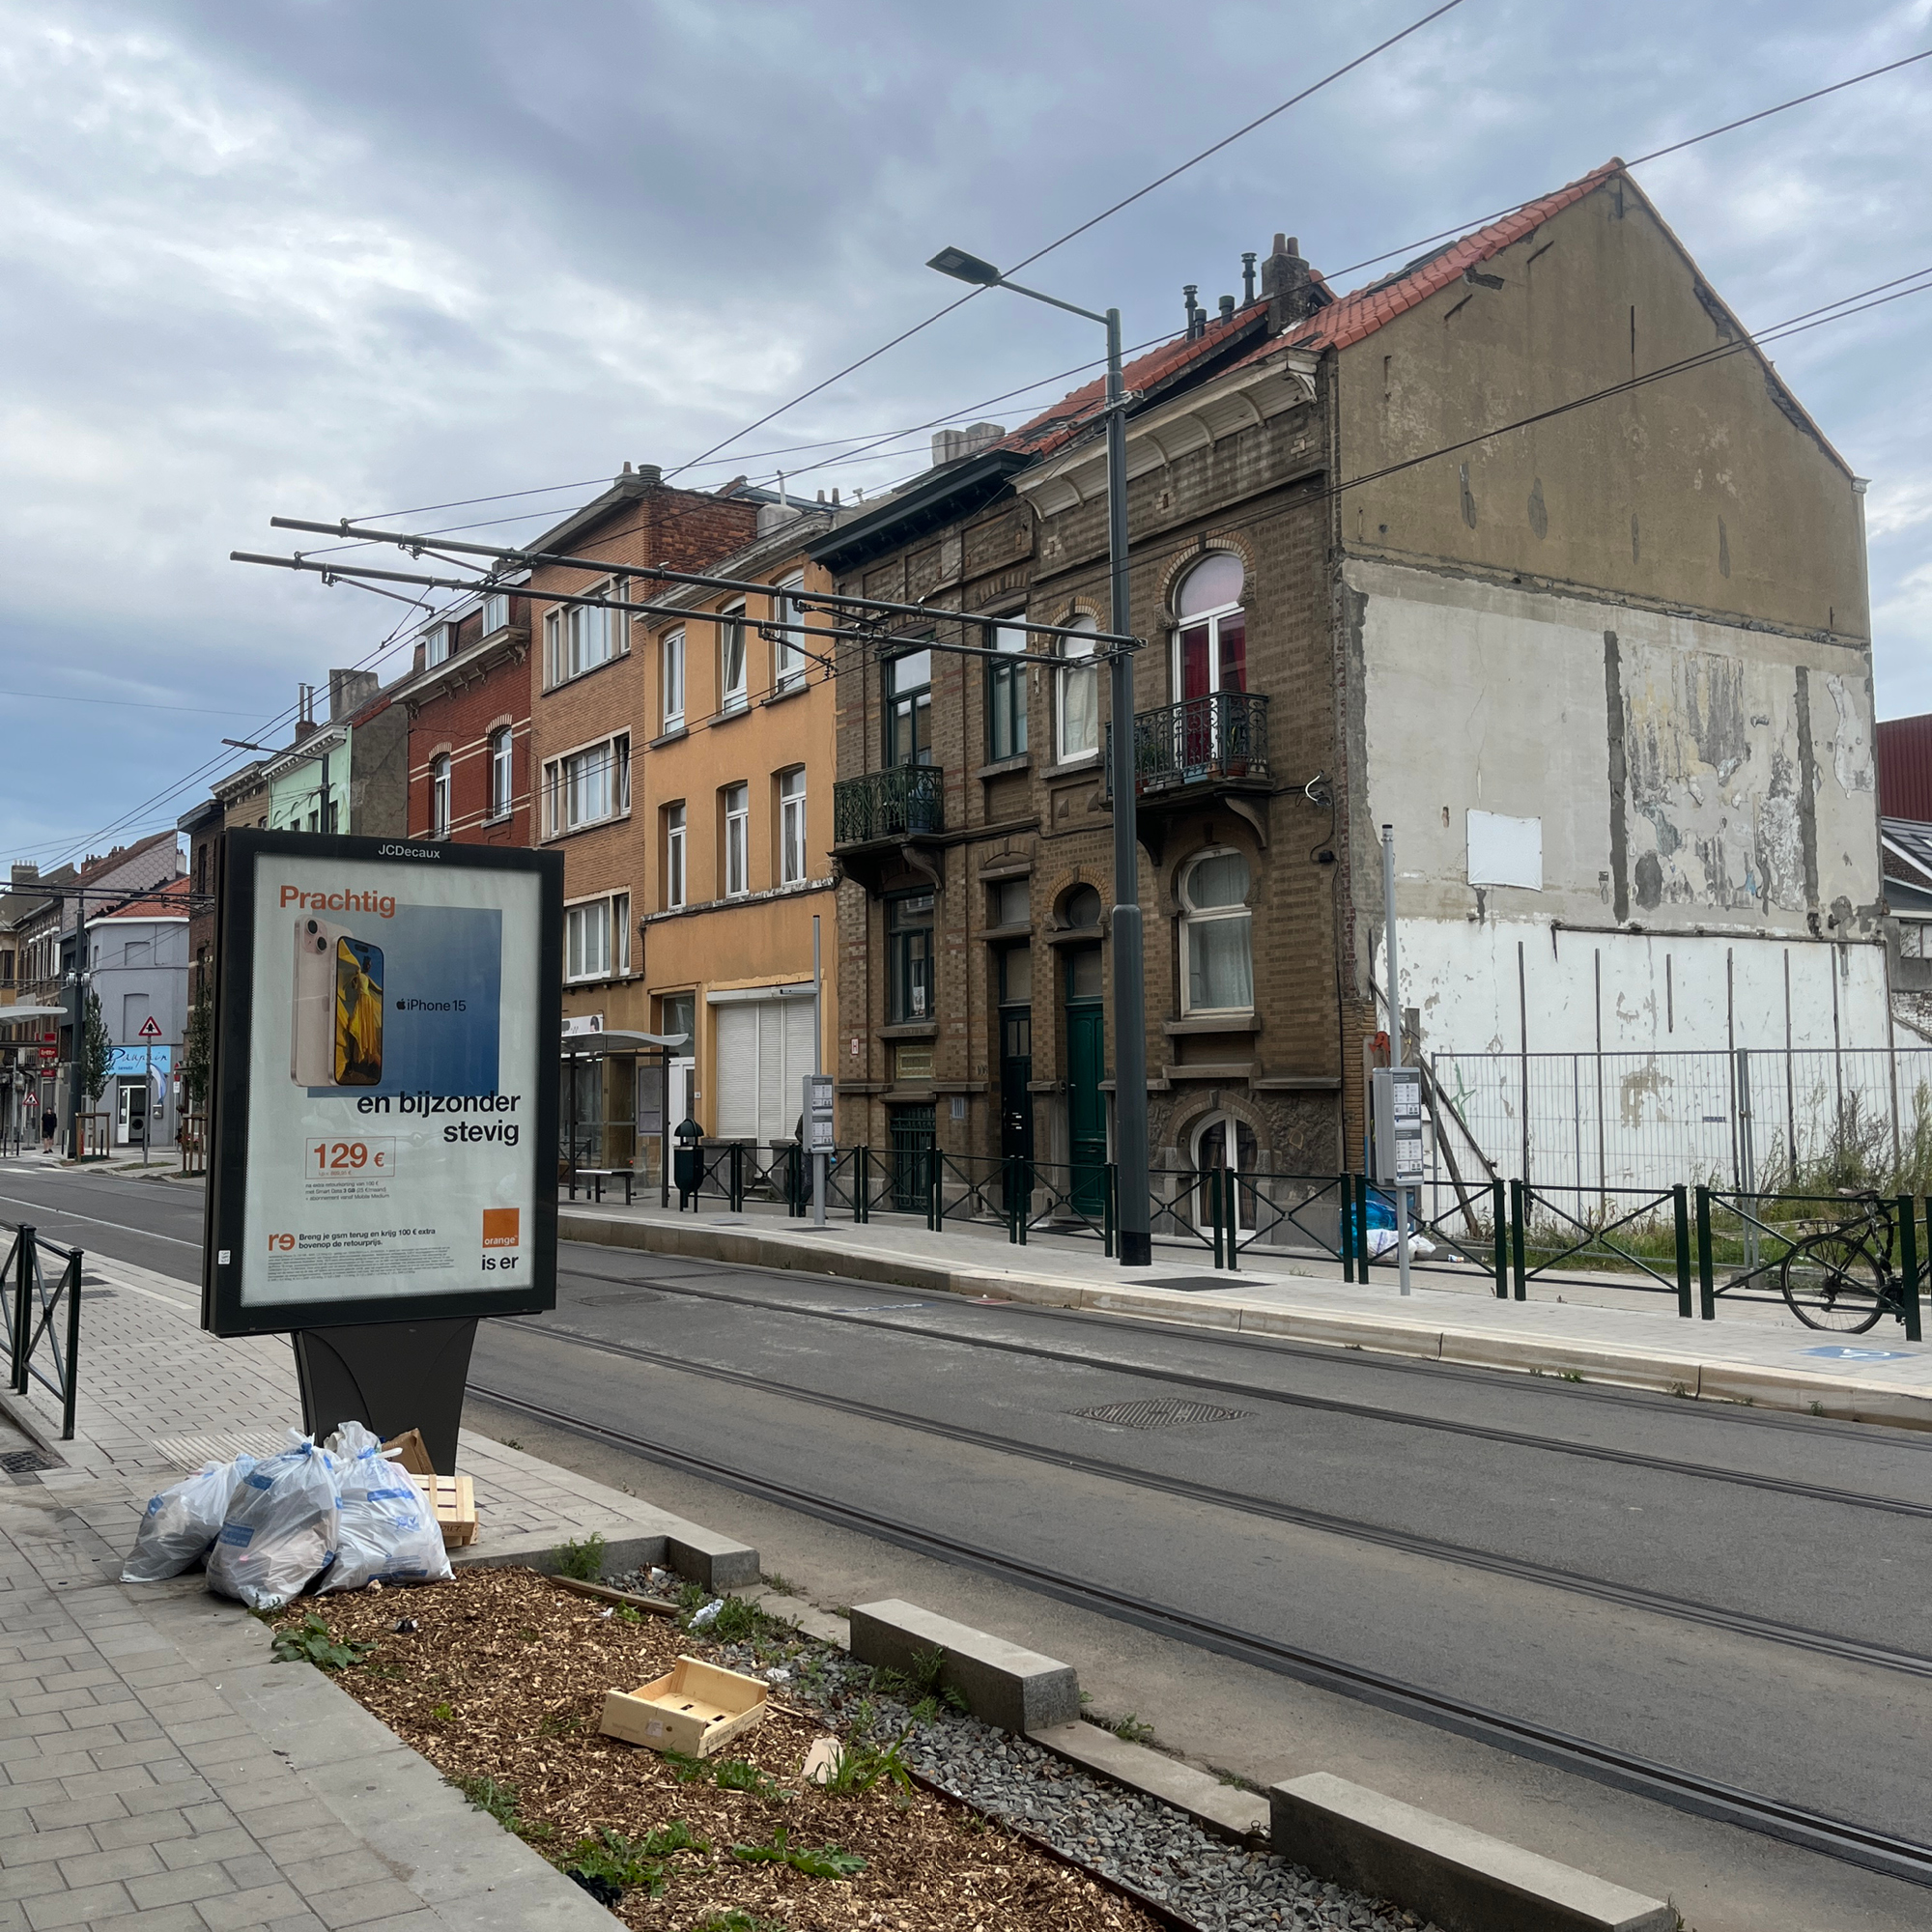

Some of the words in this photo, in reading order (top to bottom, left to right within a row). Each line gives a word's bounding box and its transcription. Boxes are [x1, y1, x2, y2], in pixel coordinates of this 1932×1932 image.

[378, 844, 440, 859] JCDecaux
[279, 885, 396, 919] Prachtig
[407, 999, 450, 1011] iPhone
[452, 1000, 467, 1011] 15
[356, 1095, 390, 1114] en
[399, 1091, 521, 1118] bijzonder
[443, 1120, 519, 1146] stevig
[314, 1143, 368, 1168] 129
[373, 1151, 384, 1167] €
[343, 1238, 383, 1247] retourprijs.
[484, 1236, 516, 1246] orange
[481, 1254, 497, 1270] is
[499, 1256, 519, 1269] er
